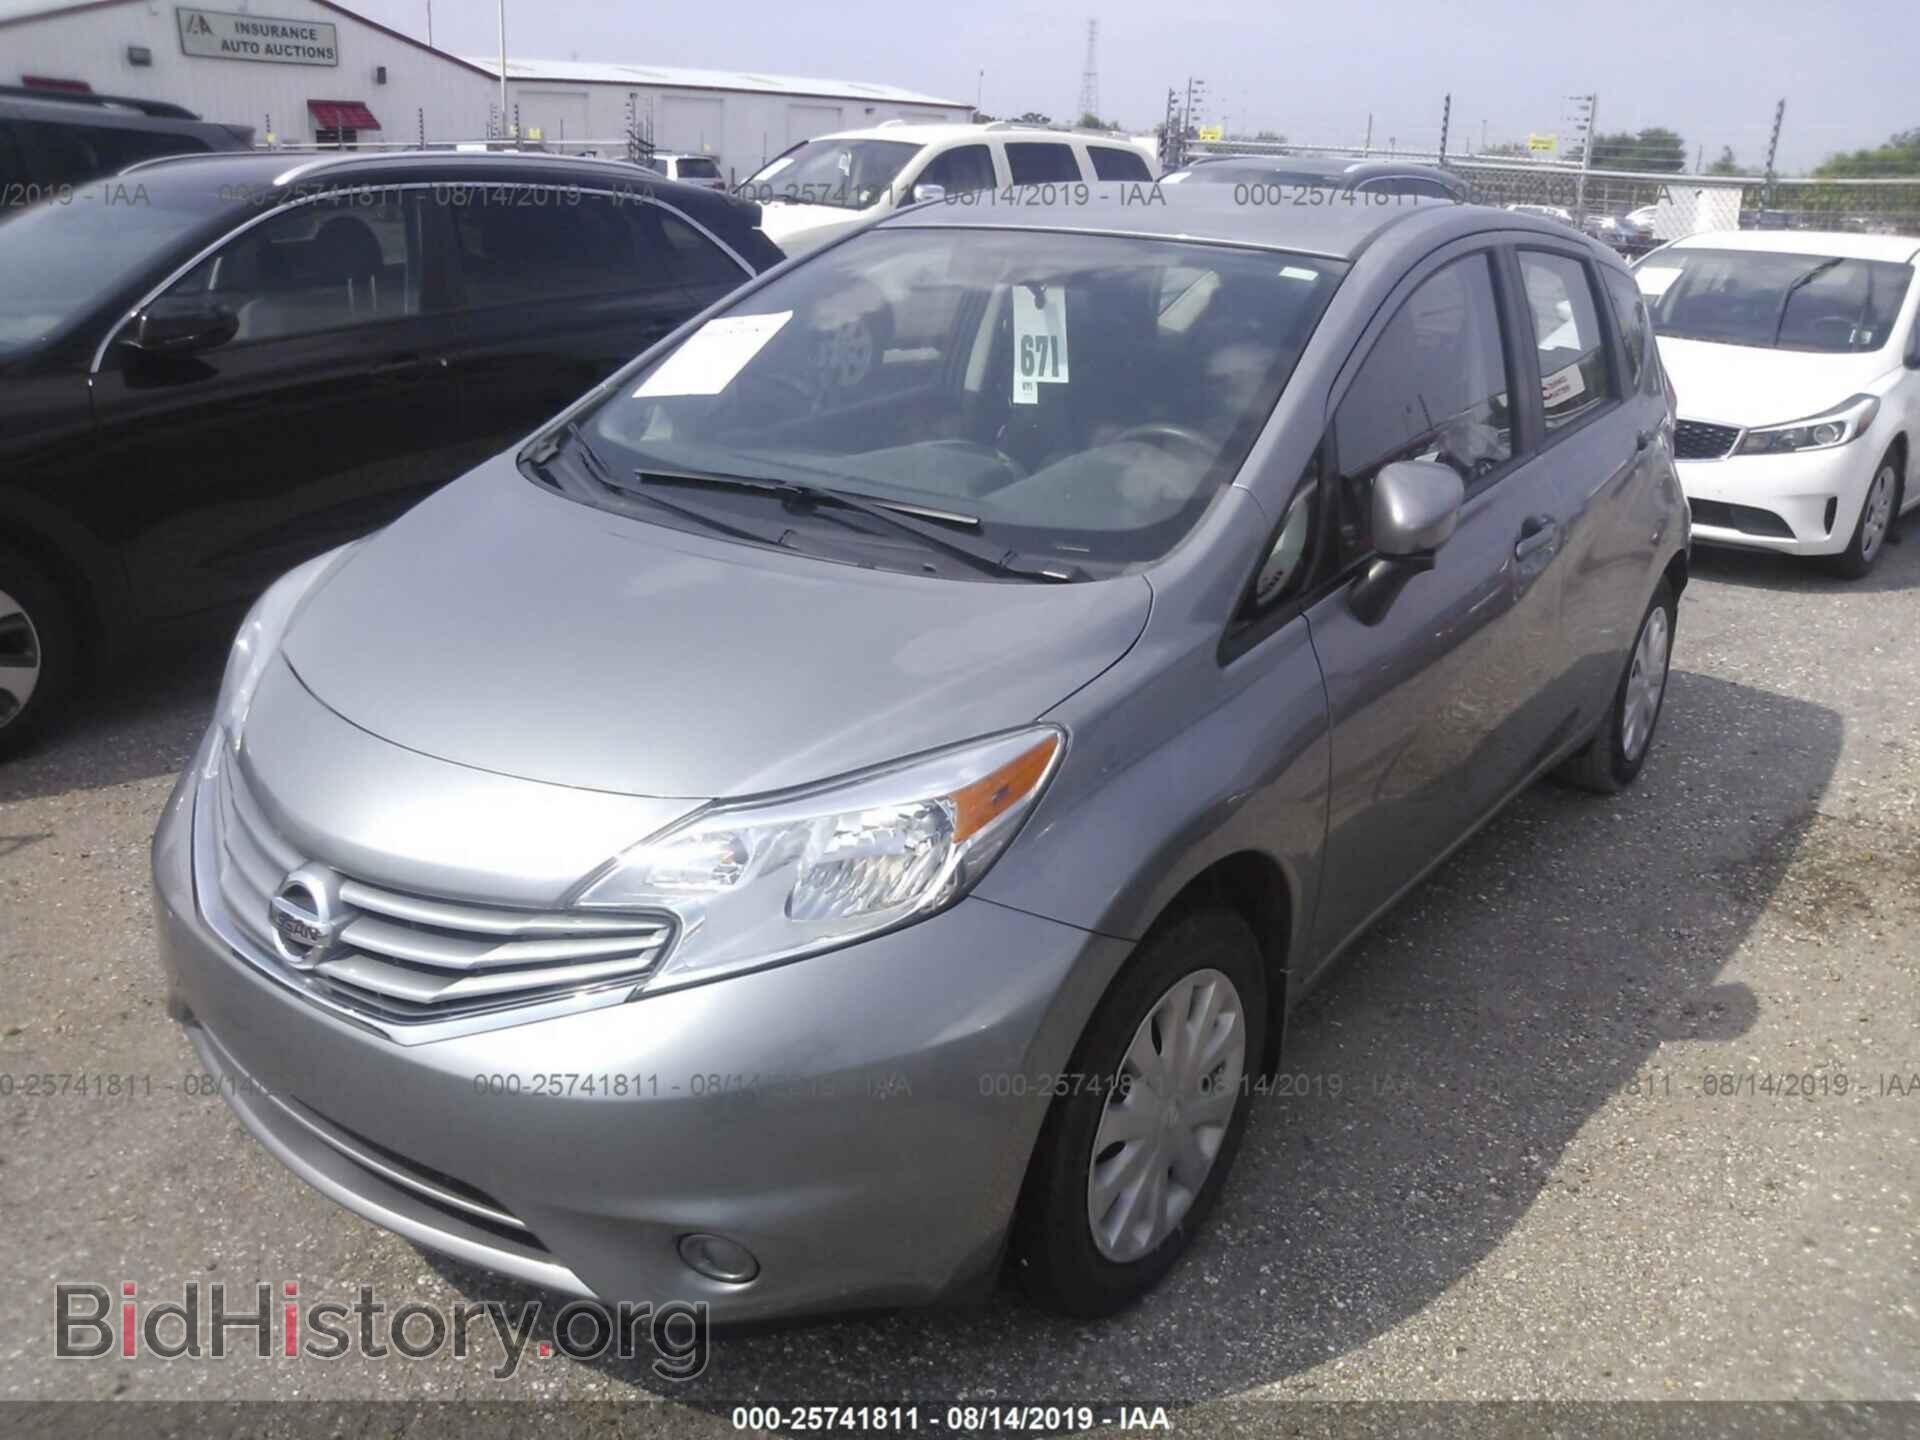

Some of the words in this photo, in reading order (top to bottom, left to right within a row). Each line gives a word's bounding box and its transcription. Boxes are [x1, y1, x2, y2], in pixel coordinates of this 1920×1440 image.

[234, 21, 318, 41] INSURANCE
[221, 39, 260, 55] AUTO
[264, 43, 334, 60] AUCTIONS
[1020, 334, 1060, 377] 671
